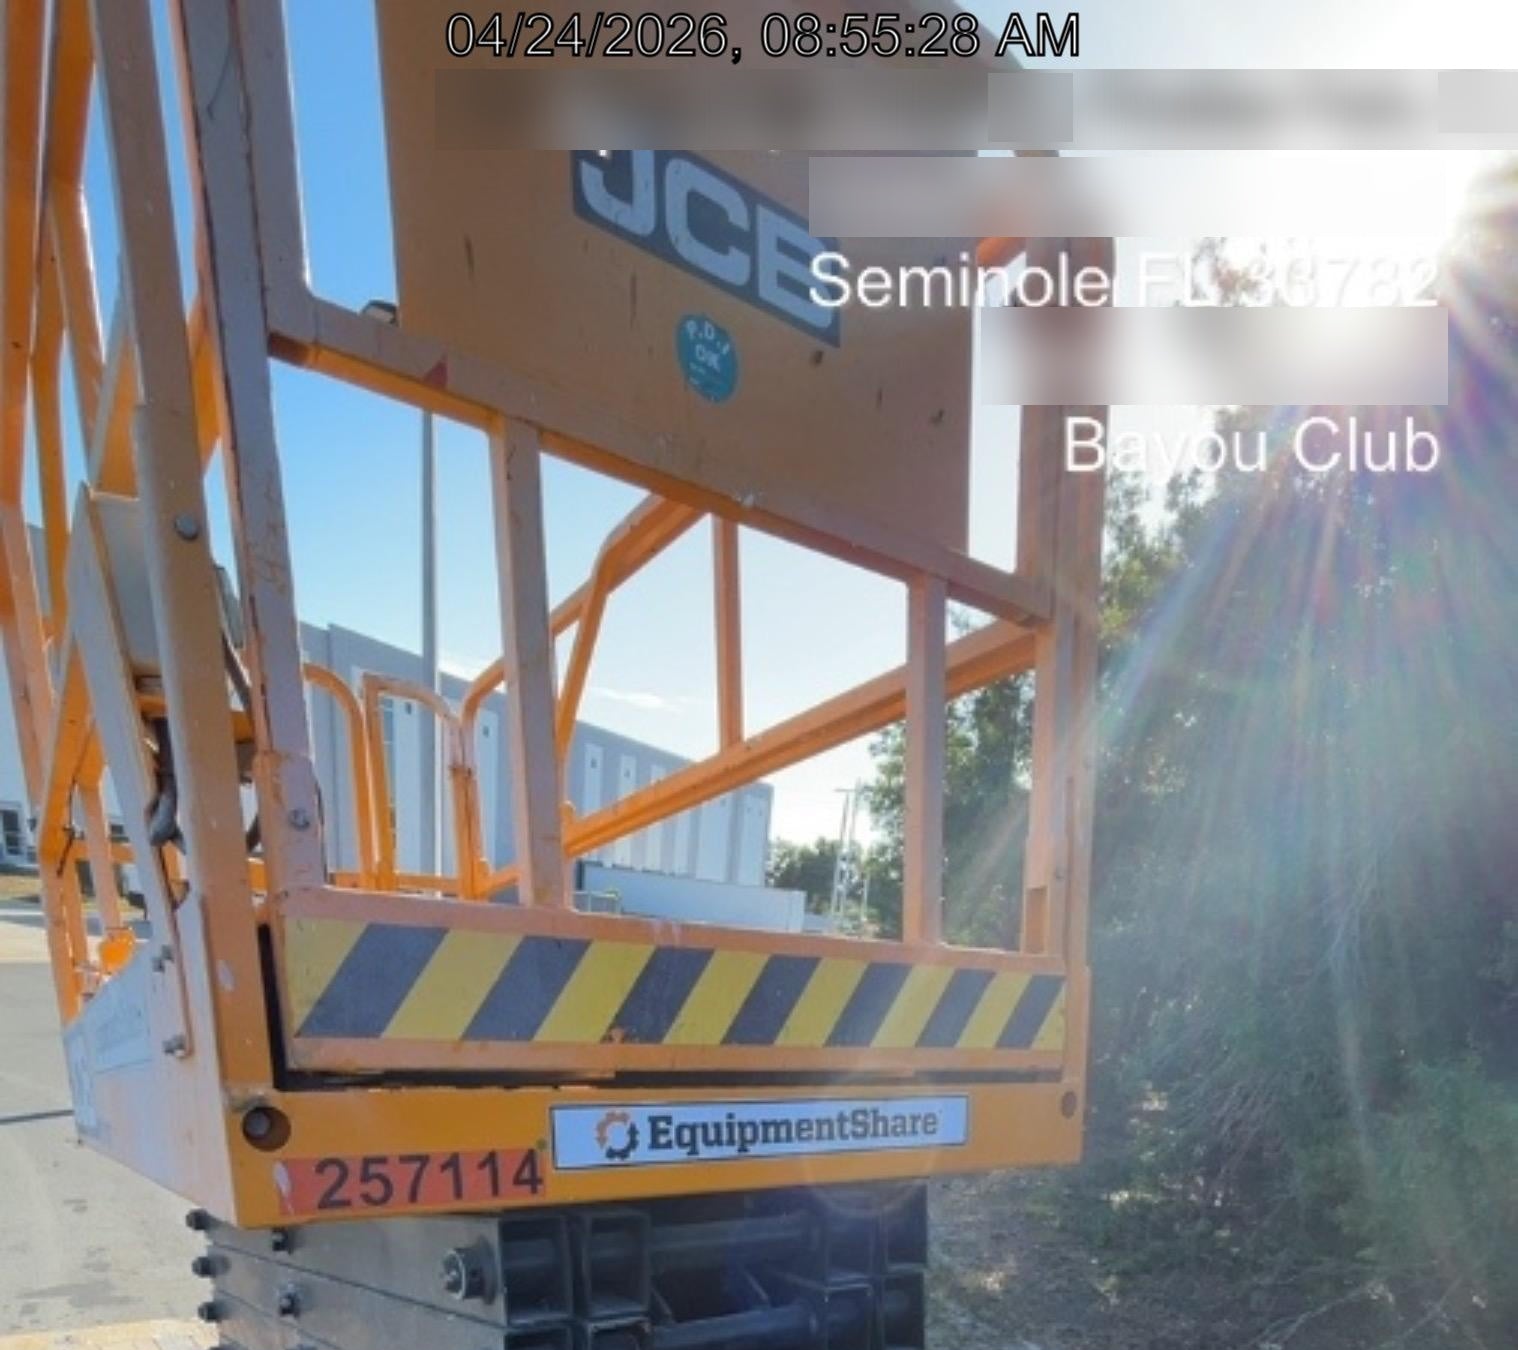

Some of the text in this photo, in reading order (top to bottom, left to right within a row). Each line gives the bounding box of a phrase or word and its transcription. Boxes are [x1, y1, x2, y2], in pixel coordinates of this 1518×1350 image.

[580, 149, 834, 329] JCB
[647, 1108, 939, 1156] EquipmentShare
[314, 1149, 543, 1210] 257114
